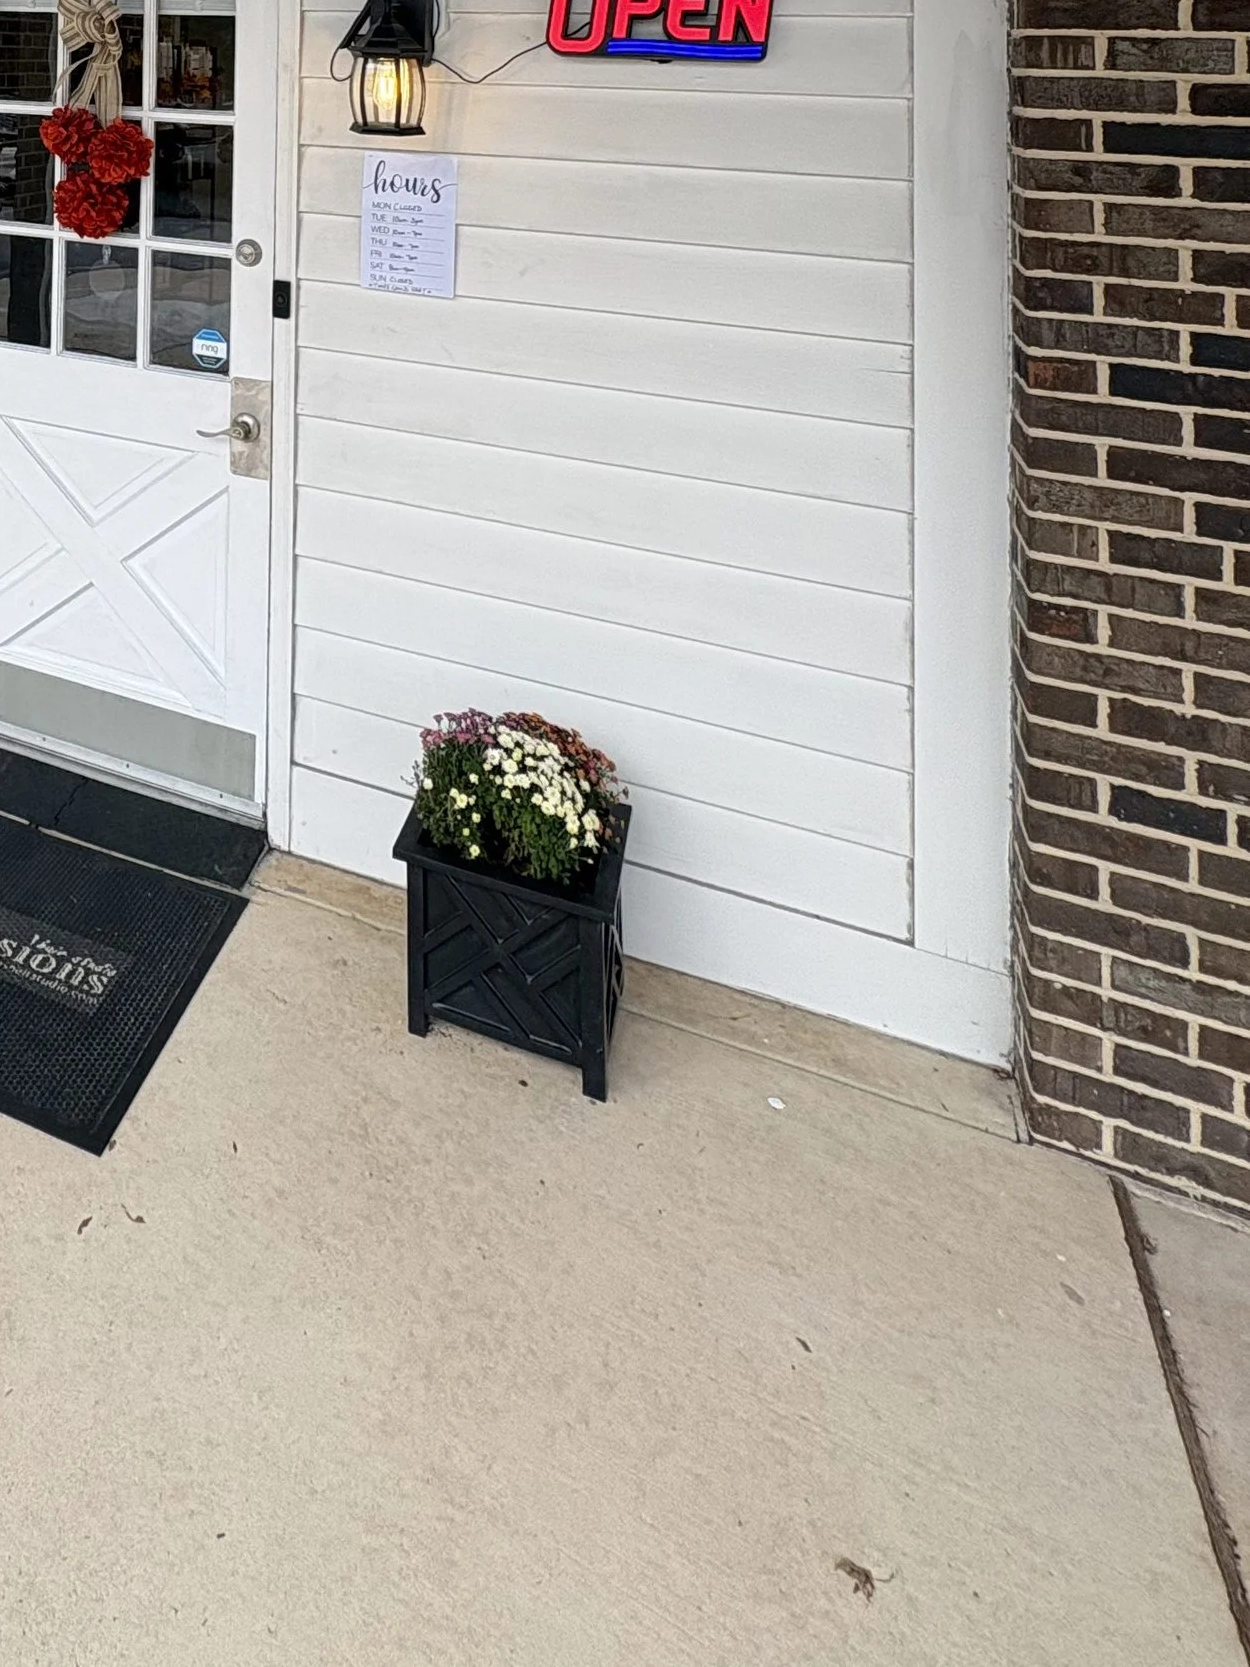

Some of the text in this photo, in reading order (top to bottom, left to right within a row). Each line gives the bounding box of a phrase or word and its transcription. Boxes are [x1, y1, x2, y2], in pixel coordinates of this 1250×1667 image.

[363, 160, 457, 203] hours
[372, 201, 391, 210] MON
[371, 213, 387, 222] TUE
[370, 225, 390, 234] WED
[370, 237, 387, 246] THU
[370, 249, 382, 258] FRI
[370, 262, 384, 270] SAT
[370, 274, 386, 282] SUN
[201, 343, 219, 354] ring
